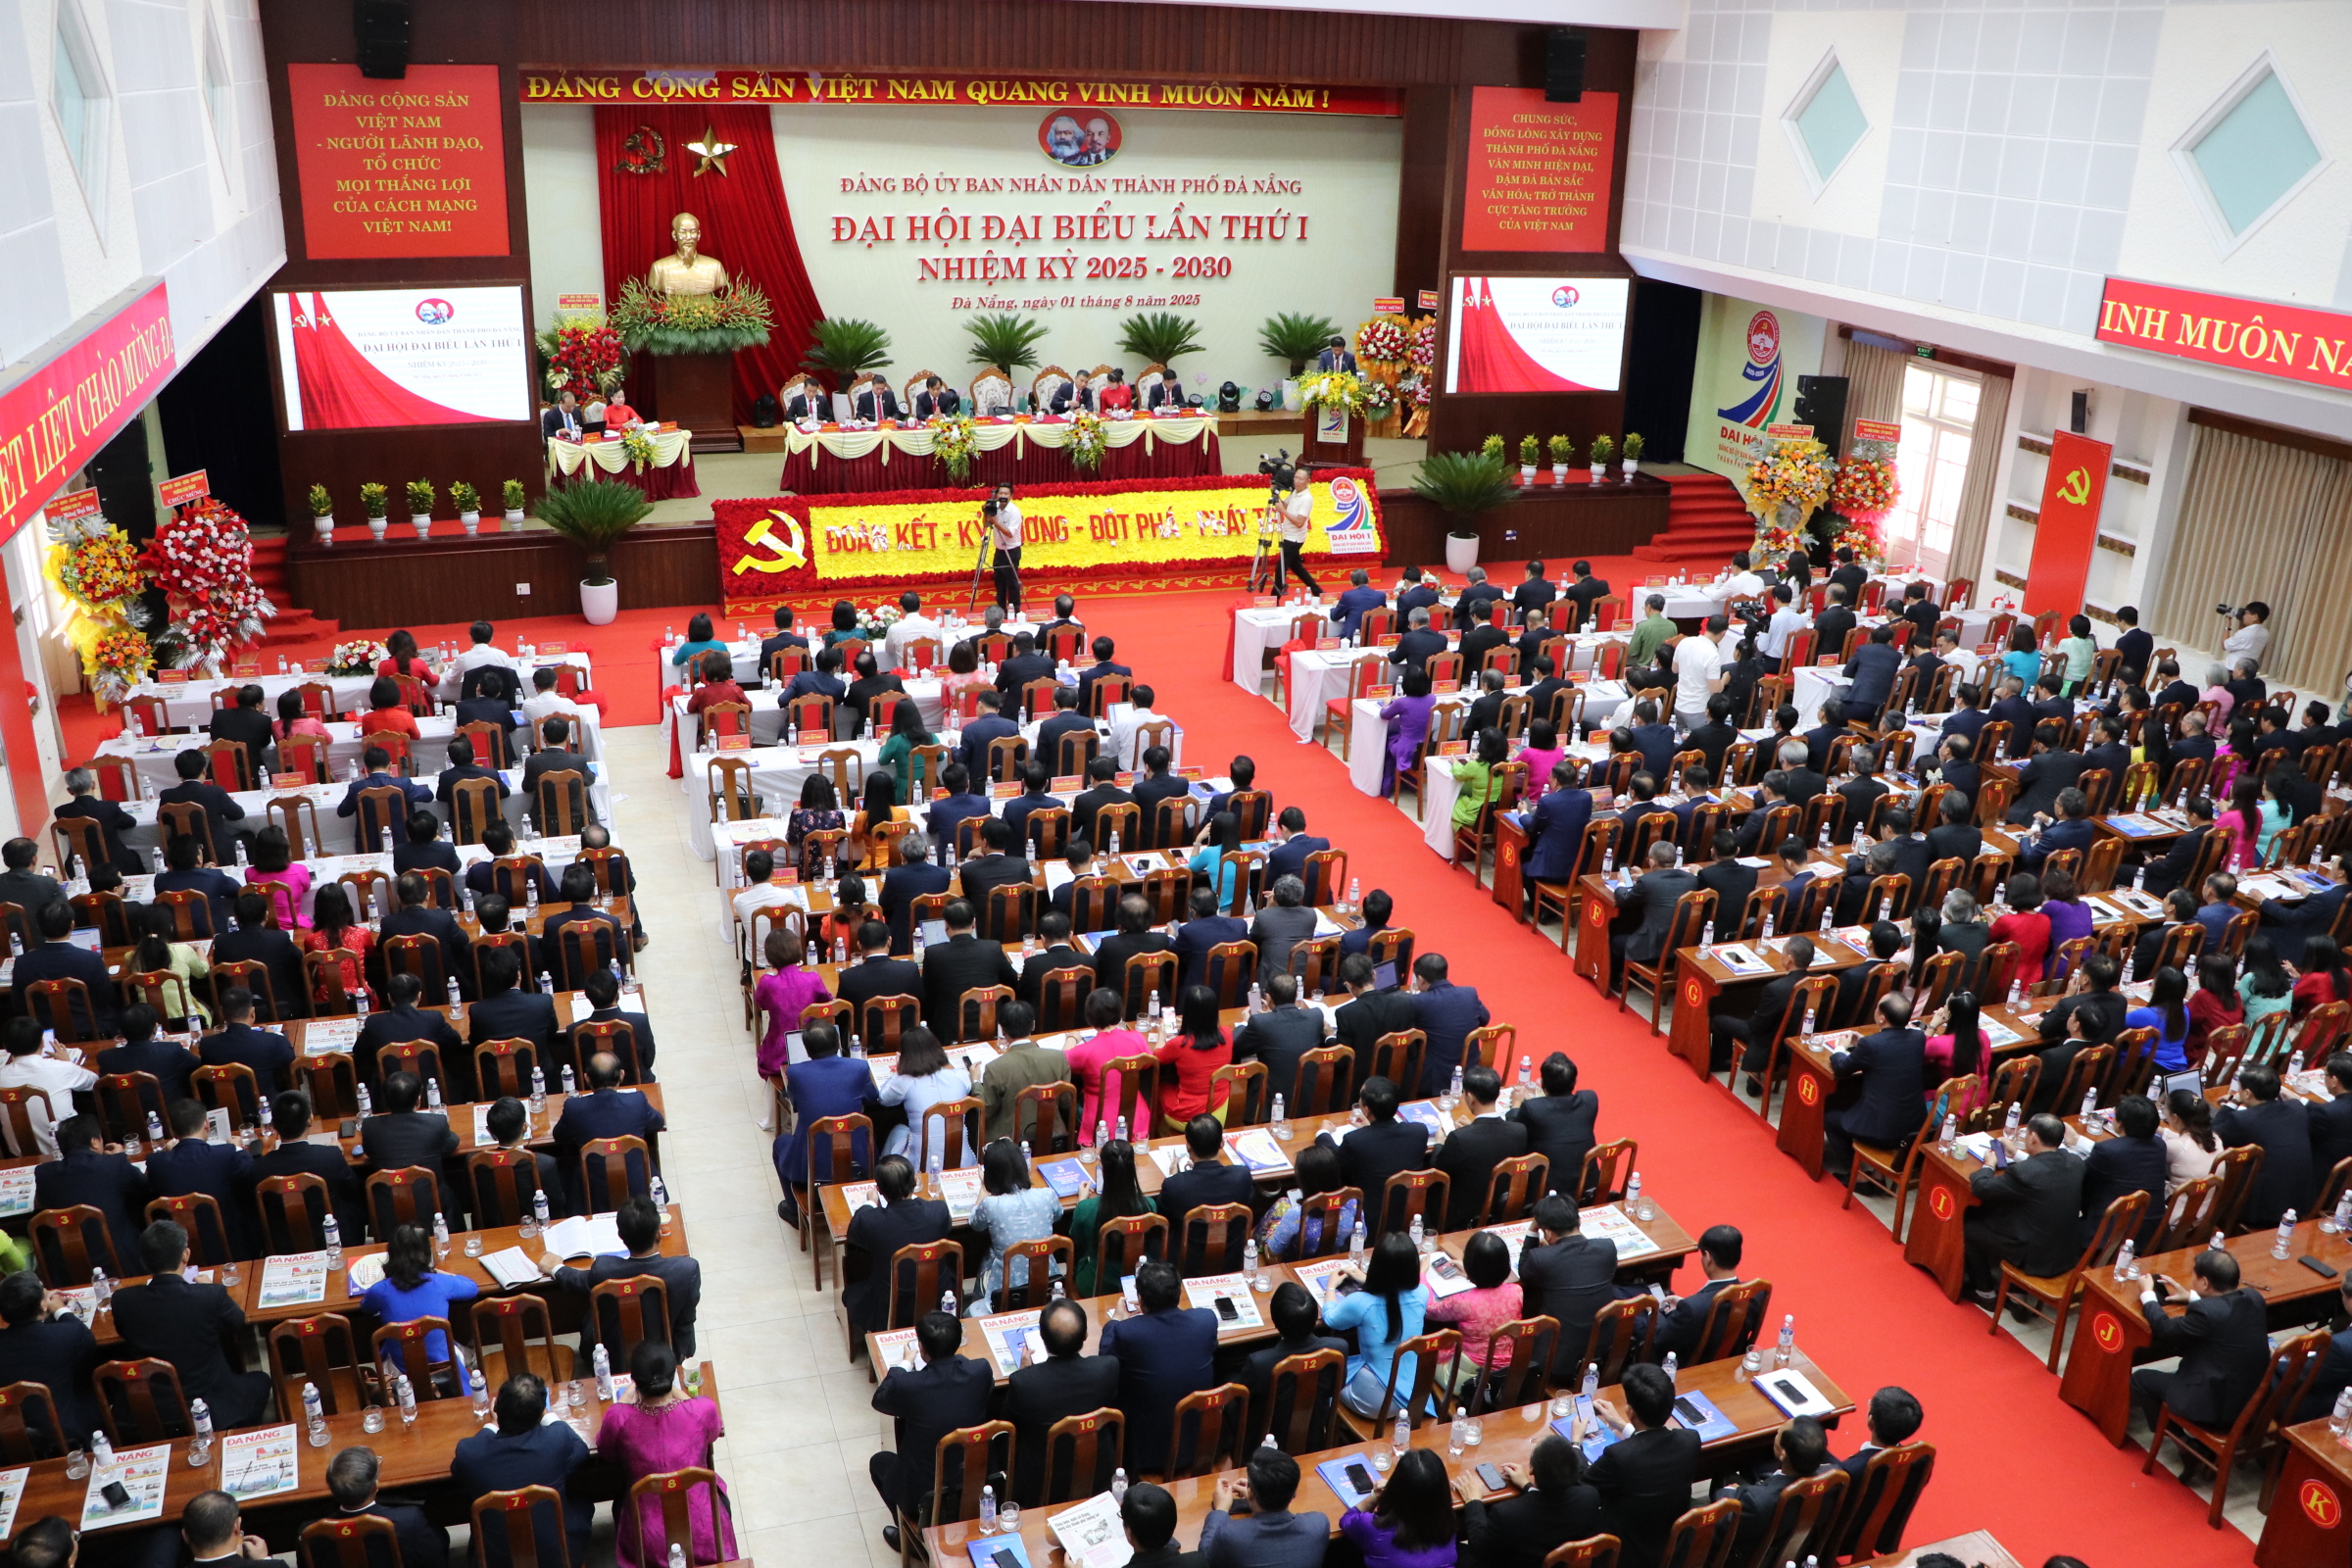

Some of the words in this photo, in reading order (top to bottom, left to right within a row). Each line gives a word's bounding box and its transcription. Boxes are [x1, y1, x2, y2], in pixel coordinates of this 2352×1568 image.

[527, 69, 621, 98] ĐẢNG
[632, 72, 720, 102] CỘNG
[732, 70, 794, 98] SẢN
[805, 73, 877, 103] VIỆT
[887, 79, 956, 100] NAM
[967, 81, 1069, 104] QUANG
[1078, 82, 1151, 104] VINH
[1160, 81, 1245, 106] MUÔN
[1253, 83, 1315, 108] NĂM
[324, 90, 375, 106] ĐẢNG
[380, 92, 430, 109] CỘNG
[435, 90, 469, 106] SẢN
[356, 113, 397, 131] VIỆT
[403, 117, 441, 128] NAM
[1513, 114, 1551, 124] CHUNG
[1519, 127, 1547, 139] LÒNG
[1550, 128, 1570, 139] XÂY
[1573, 131, 1602, 143] DỰNG
[327, 137, 385, 150] NGƯỜI
[390, 135, 438, 149] LÃNH
[443, 137, 484, 152] ĐẠO,
[1486, 142, 1523, 154] THÀNH
[1527, 142, 1550, 154] PHỐ
[1552, 144, 1566, 155] ĐÀ
[363, 152, 387, 170] TỔ
[392, 155, 441, 170] CHỨC
[1488, 158, 1510, 168] VĂN
[1513, 160, 1541, 169] MINH
[1544, 159, 1570, 173] HIỆN
[337, 180, 370, 196] MỌI
[375, 174, 436, 191] THẮNG
[442, 179, 471, 194] LỢI
[841, 172, 896, 192] ĐẢNG
[903, 174, 929, 195] BỘ
[935, 172, 960, 192] ỦY
[965, 178, 1004, 192] BAN
[1009, 174, 1062, 192] NHÂN
[1069, 174, 1106, 192] DÂN
[1112, 175, 1175, 193] THÀNH
[1182, 174, 1219, 193] PHỐ
[1224, 175, 1248, 193] ĐÀ
[1253, 173, 1302, 194] NẴNG
[1496, 173, 1519, 186] ĐẬM
[1523, 173, 1537, 184] ĐÀ
[1540, 174, 1561, 185] BẢN
[1564, 173, 1584, 185] SẮC
[1482, 188, 1504, 199] VĂN
[1534, 189, 1556, 200] TRỞ
[1558, 190, 1594, 201] THÀNH
[333, 196, 370, 212] CỦA
[374, 197, 422, 212] CÁCH
[427, 199, 478, 214] MẠNG
[1488, 205, 1509, 216] CỰC
[1513, 204, 1541, 215] TĂNG
[363, 218, 404, 235] VIỆT
[409, 220, 452, 232] NAM!
[832, 216, 895, 248] ĐẠI
[907, 207, 971, 248] HỘI
[981, 215, 1043, 246] ĐẠI
[1053, 200, 1136, 239] BIỂU
[1145, 202, 1211, 239] LẦN
[1221, 208, 1291, 239] THỨ
[1297, 216, 1308, 239] I
[1499, 218, 1521, 229] CỦA
[1524, 219, 1548, 232] VIỆT
[1551, 222, 1574, 230] NAM
[918, 249, 1027, 286] NHIỆM
[1037, 248, 1078, 279] KỲ
[1087, 257, 1147, 278] 2025
[1172, 256, 1231, 278] 2030
[952, 297, 971, 310] Đà
[1023, 296, 1057, 311] ngày
[1060, 296, 1075, 307] 01
[1080, 295, 1121, 309] tháng
[1125, 295, 1132, 307] 8
[1136, 296, 1166, 307] năm
[1169, 294, 1200, 306] 2025
[2175, 315, 2302, 366] MUÔN
[26, 387, 76, 484] LIỆT
[76, 350, 122, 437] CHÀO
[119, 322, 162, 397] MỪNG
[1720, 426, 1740, 443] ĐẠI
[825, 519, 889, 553] ĐOÀN
[896, 514, 938, 551] KẾT
[1090, 507, 1129, 546] ĐỘT
[1135, 506, 1182, 539] PHÁ
[1195, 503, 1248, 537] PHÁT
[1504, 847, 1512, 862] E
[1592, 905, 1602, 920] F
[1689, 984, 1698, 1002] G
[1801, 1079, 1814, 1100] H
[287, 1181, 296, 1191] 5
[1937, 1195, 1947, 1211] I
[60, 1215, 70, 1225] 3
[923, 1250, 933, 1259] 9
[622, 1285, 632, 1295] 8
[305, 1323, 315, 1333] 5
[405, 1327, 416, 1338] 6
[1522, 1325, 1535, 1335] 15
[2100, 1324, 2116, 1342] J
[1426, 1340, 1439, 1349] 14
[126, 1367, 137, 1377] 4
[1303, 1359, 1317, 1370] 12
[1079, 1418, 1095, 1430] 10
[972, 1433, 983, 1443] 9
[1896, 1451, 1912, 1463] 17
[667, 1479, 677, 1489] 8
[512, 1496, 520, 1507] 7
[2305, 1488, 2331, 1520] K
[341, 1526, 352, 1536] 6
